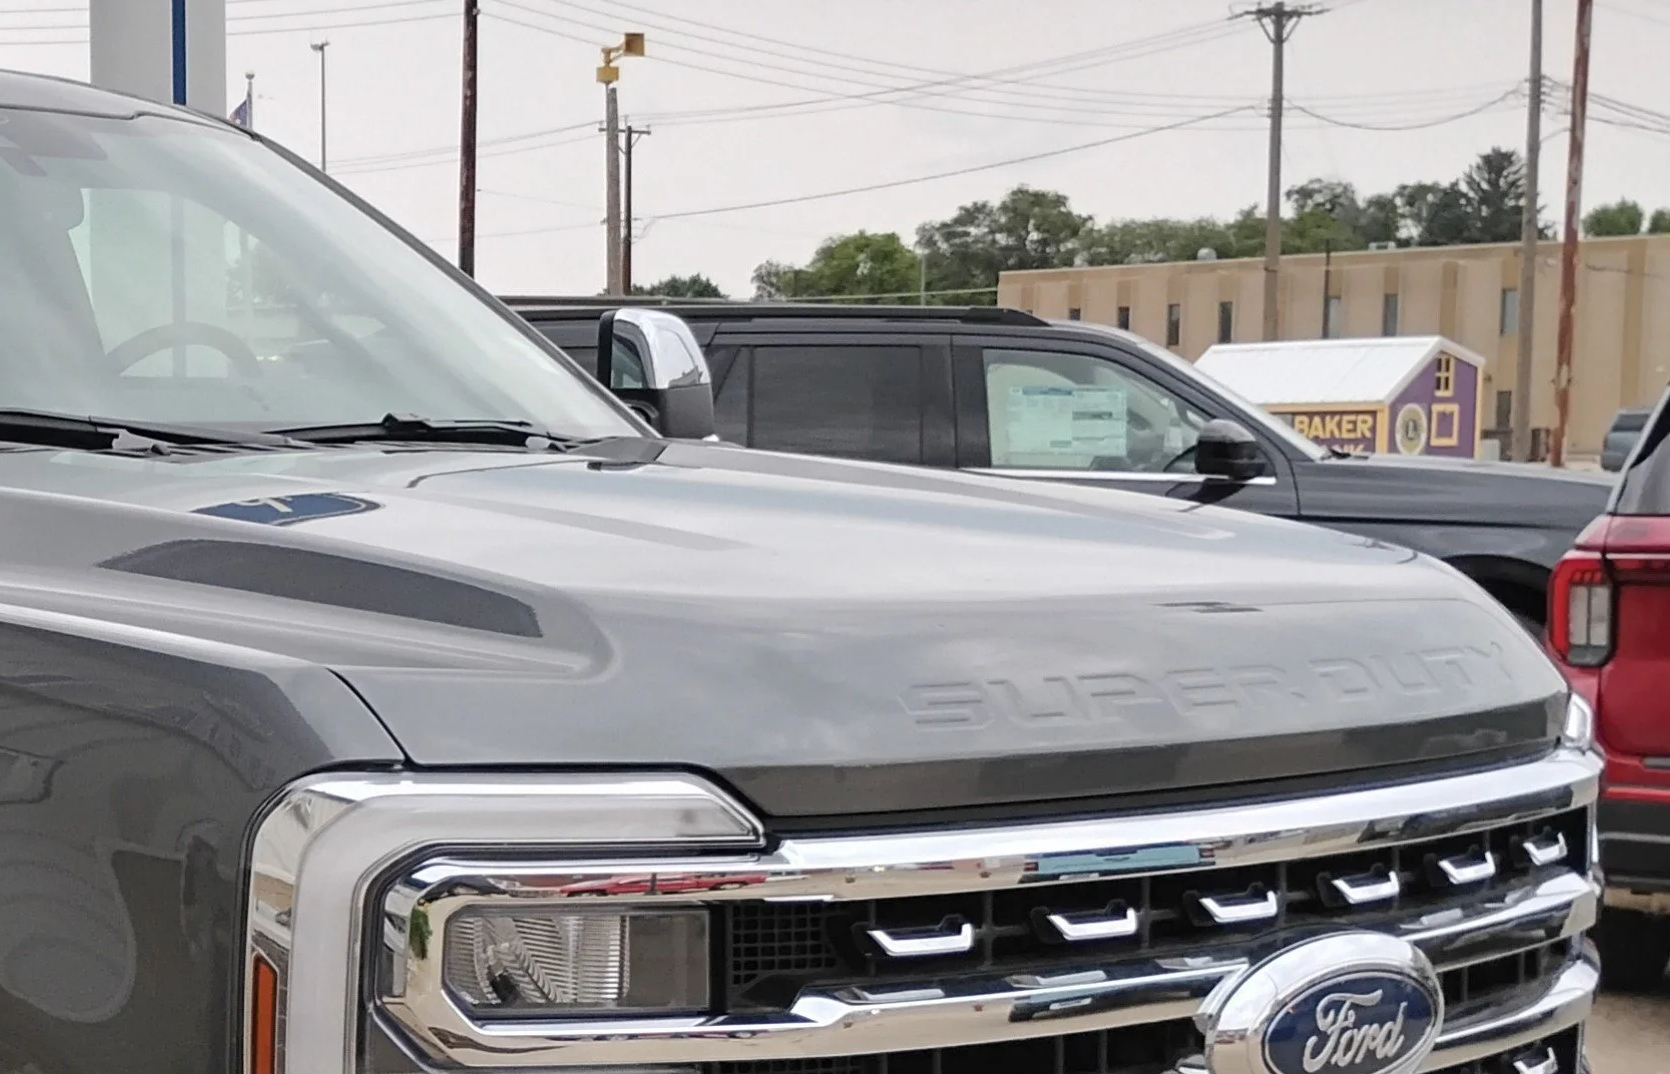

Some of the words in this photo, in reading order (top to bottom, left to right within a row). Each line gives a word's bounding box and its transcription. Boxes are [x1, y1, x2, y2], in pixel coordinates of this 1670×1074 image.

[1294, 413, 1372, 438] BAKER
[897, 664, 1307, 732] SUPER
[1310, 640, 1514, 702] DUTY
[1303, 988, 1408, 1073] Ford
